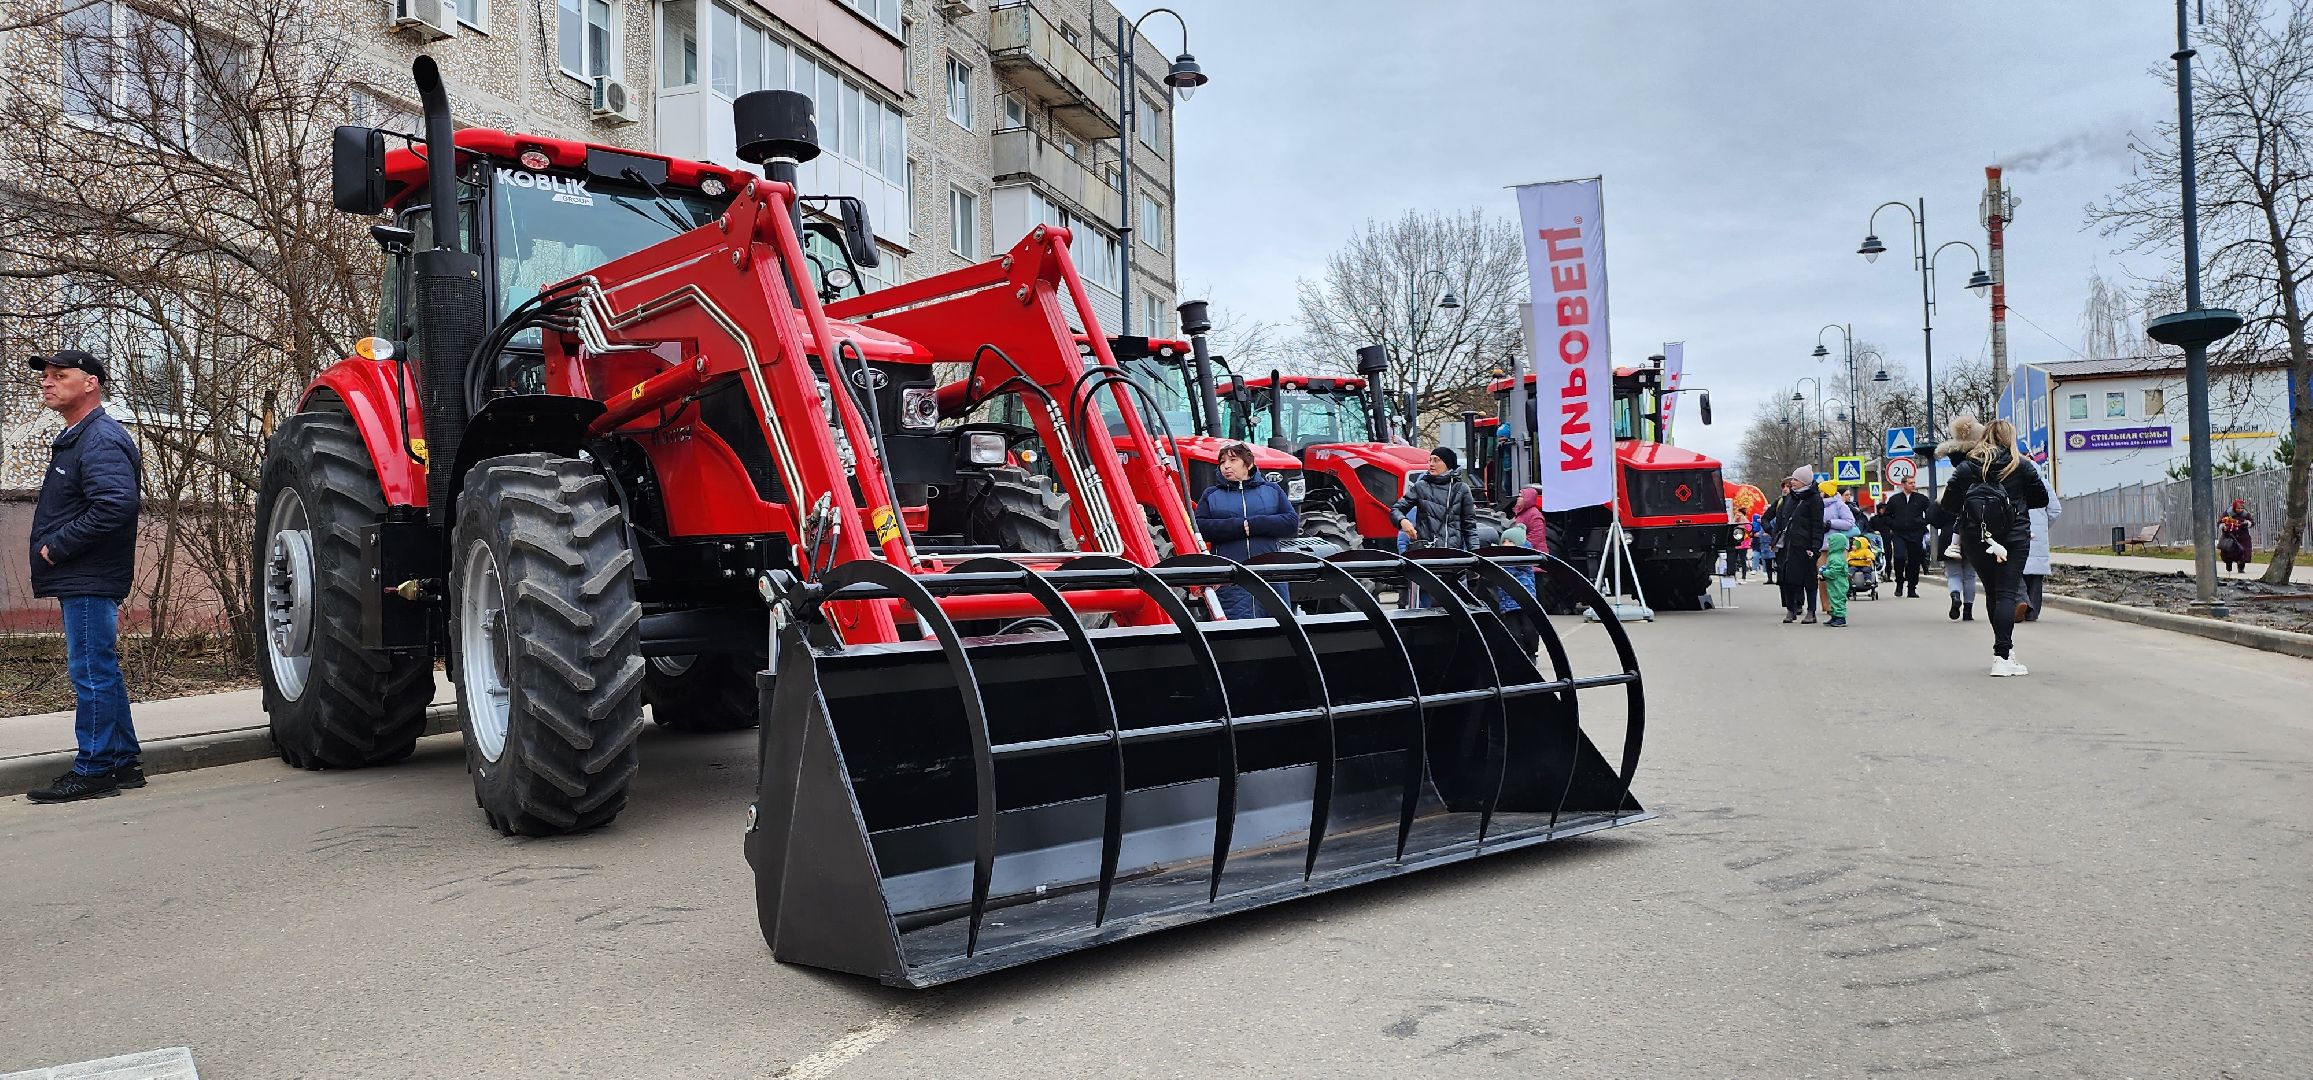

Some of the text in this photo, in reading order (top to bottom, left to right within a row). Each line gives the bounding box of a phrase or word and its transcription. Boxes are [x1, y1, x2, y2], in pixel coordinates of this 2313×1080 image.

[562, 195, 590, 204] GROUP
[2091, 433, 2138, 442] СТИЛЬНАЯ
[2139, 431, 2168, 439] СЕМЬЯ
[1893, 466, 1908, 477] 20
